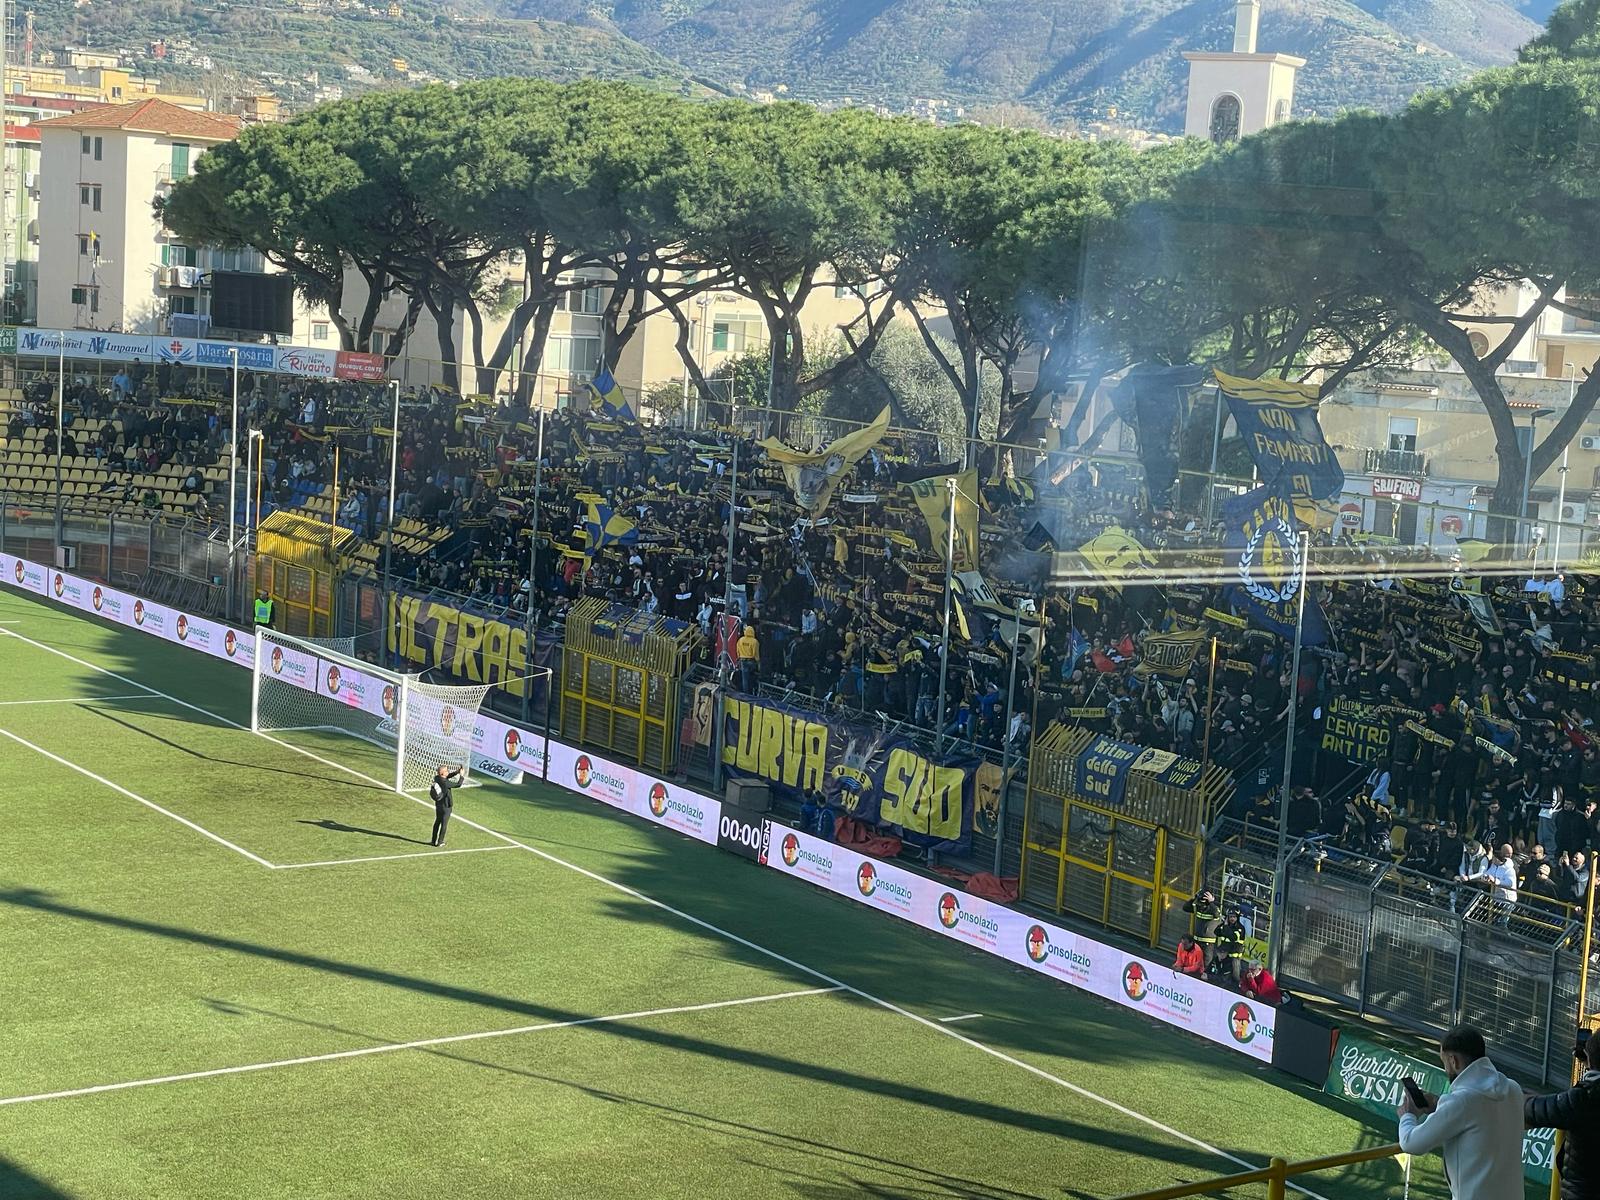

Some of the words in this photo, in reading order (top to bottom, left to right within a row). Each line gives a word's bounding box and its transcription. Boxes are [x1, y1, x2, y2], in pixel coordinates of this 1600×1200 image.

[236, 347, 272, 363] osaria
[290, 356, 331, 374] Rivauto
[1258, 408, 1296, 431] NON
[1326, 715, 1390, 745] CENTRO
[722, 696, 828, 793] CURVA
[879, 748, 966, 840] SUD
[1085, 756, 1118, 777] della
[1084, 775, 1111, 796] Sud
[1168, 771, 1192, 785] VIVE
[720, 815, 761, 850] 00:00
[1340, 1045, 1411, 1079] Giardini
[1412, 1070, 1426, 1086] DEI
